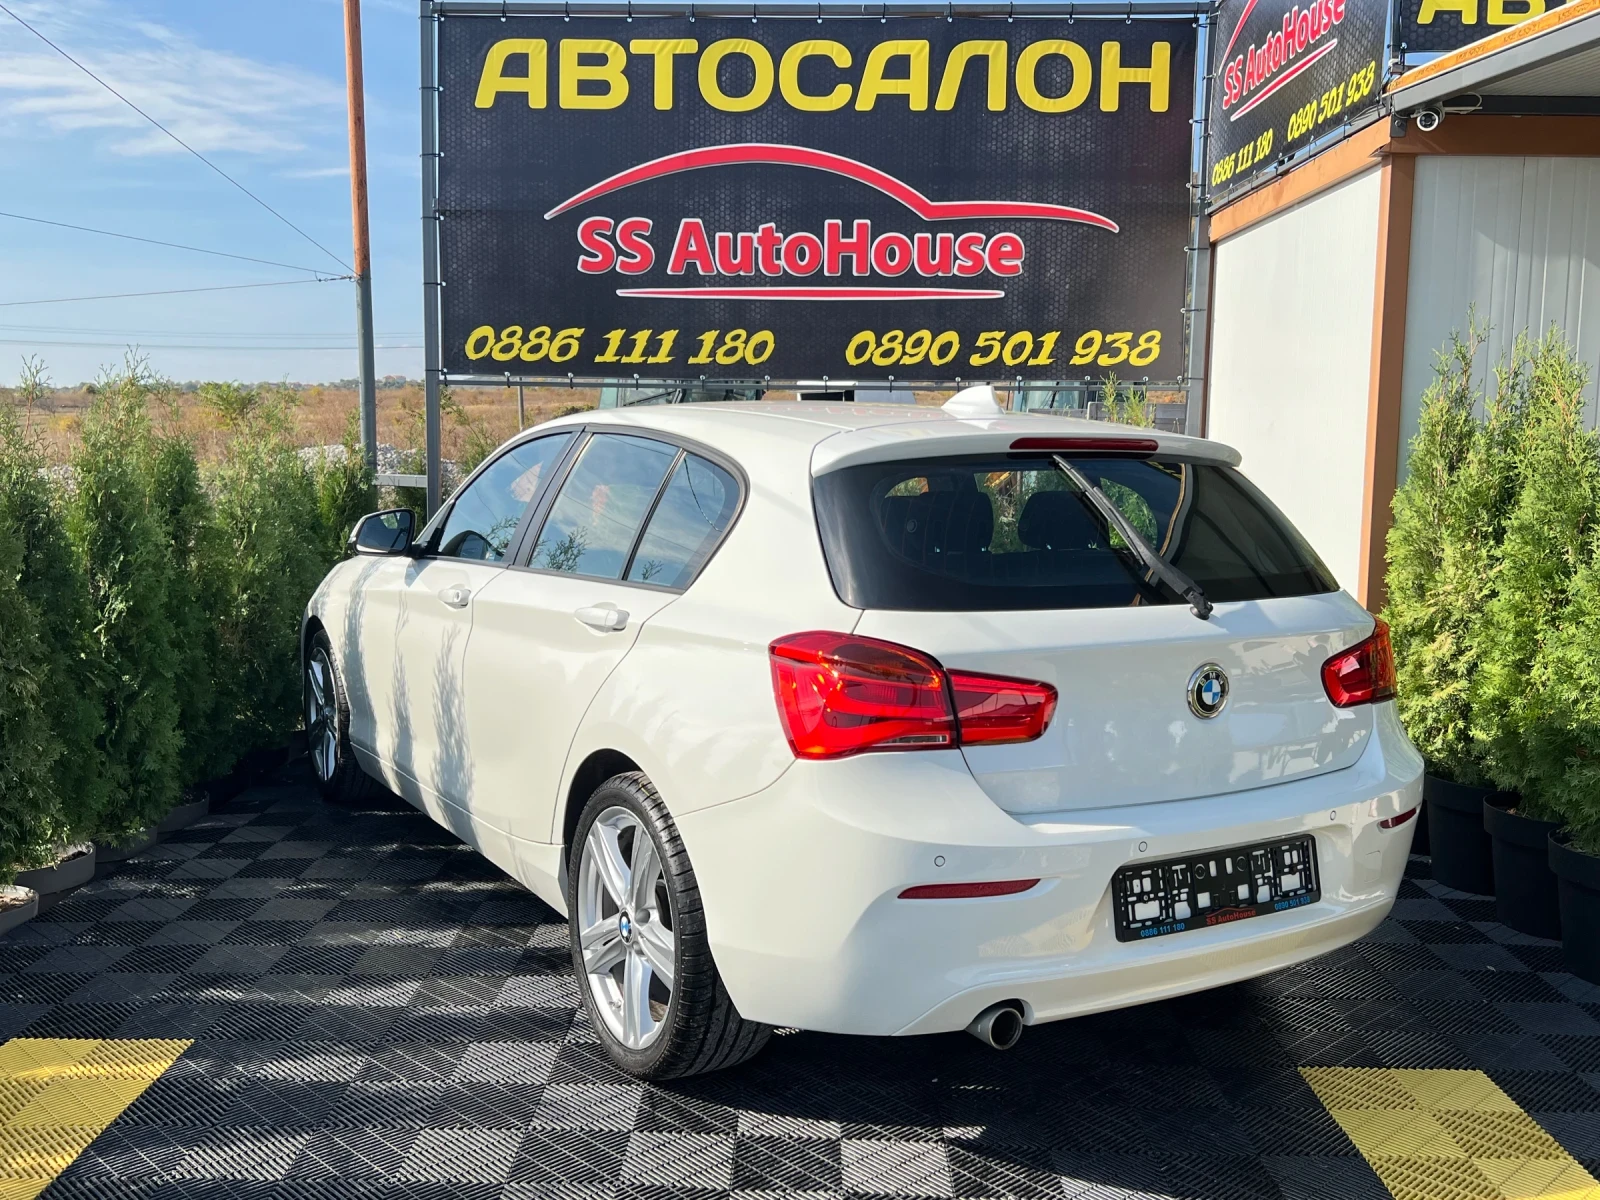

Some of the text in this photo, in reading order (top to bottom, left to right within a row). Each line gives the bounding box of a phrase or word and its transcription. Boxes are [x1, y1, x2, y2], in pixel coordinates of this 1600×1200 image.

[476, 37, 1171, 113] АВТОСАЛОН
[1223, 55, 1243, 109] SS
[1243, 0, 1345, 95] AutoHouse
[1287, 99, 1318, 143] 0890
[1317, 81, 1346, 124] 501
[1345, 60, 1377, 108] 938
[1211, 128, 1274, 187] 0886 111 180
[577, 216, 1026, 278] SS AutoHouse
[465, 325, 776, 365] 0886 111 180
[845, 328, 1163, 367] 0890 501 938
[1218, 908, 1257, 923] AutoHouse
